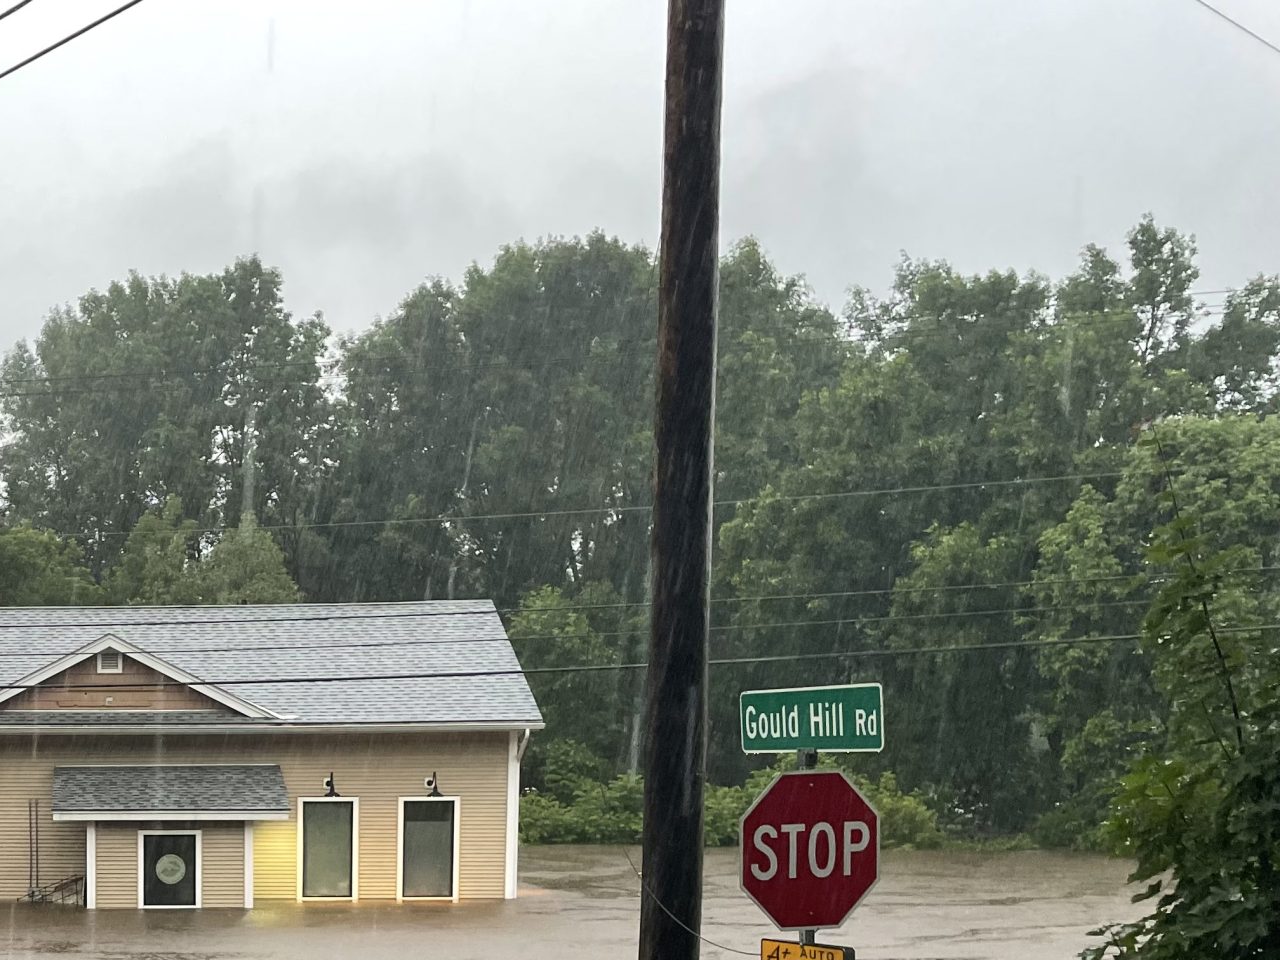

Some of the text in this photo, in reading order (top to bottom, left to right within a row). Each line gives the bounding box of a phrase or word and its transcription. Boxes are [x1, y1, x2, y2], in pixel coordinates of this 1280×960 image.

[745, 702, 877, 739] Gould Hill Rd
[750, 820, 871, 881] STOP
